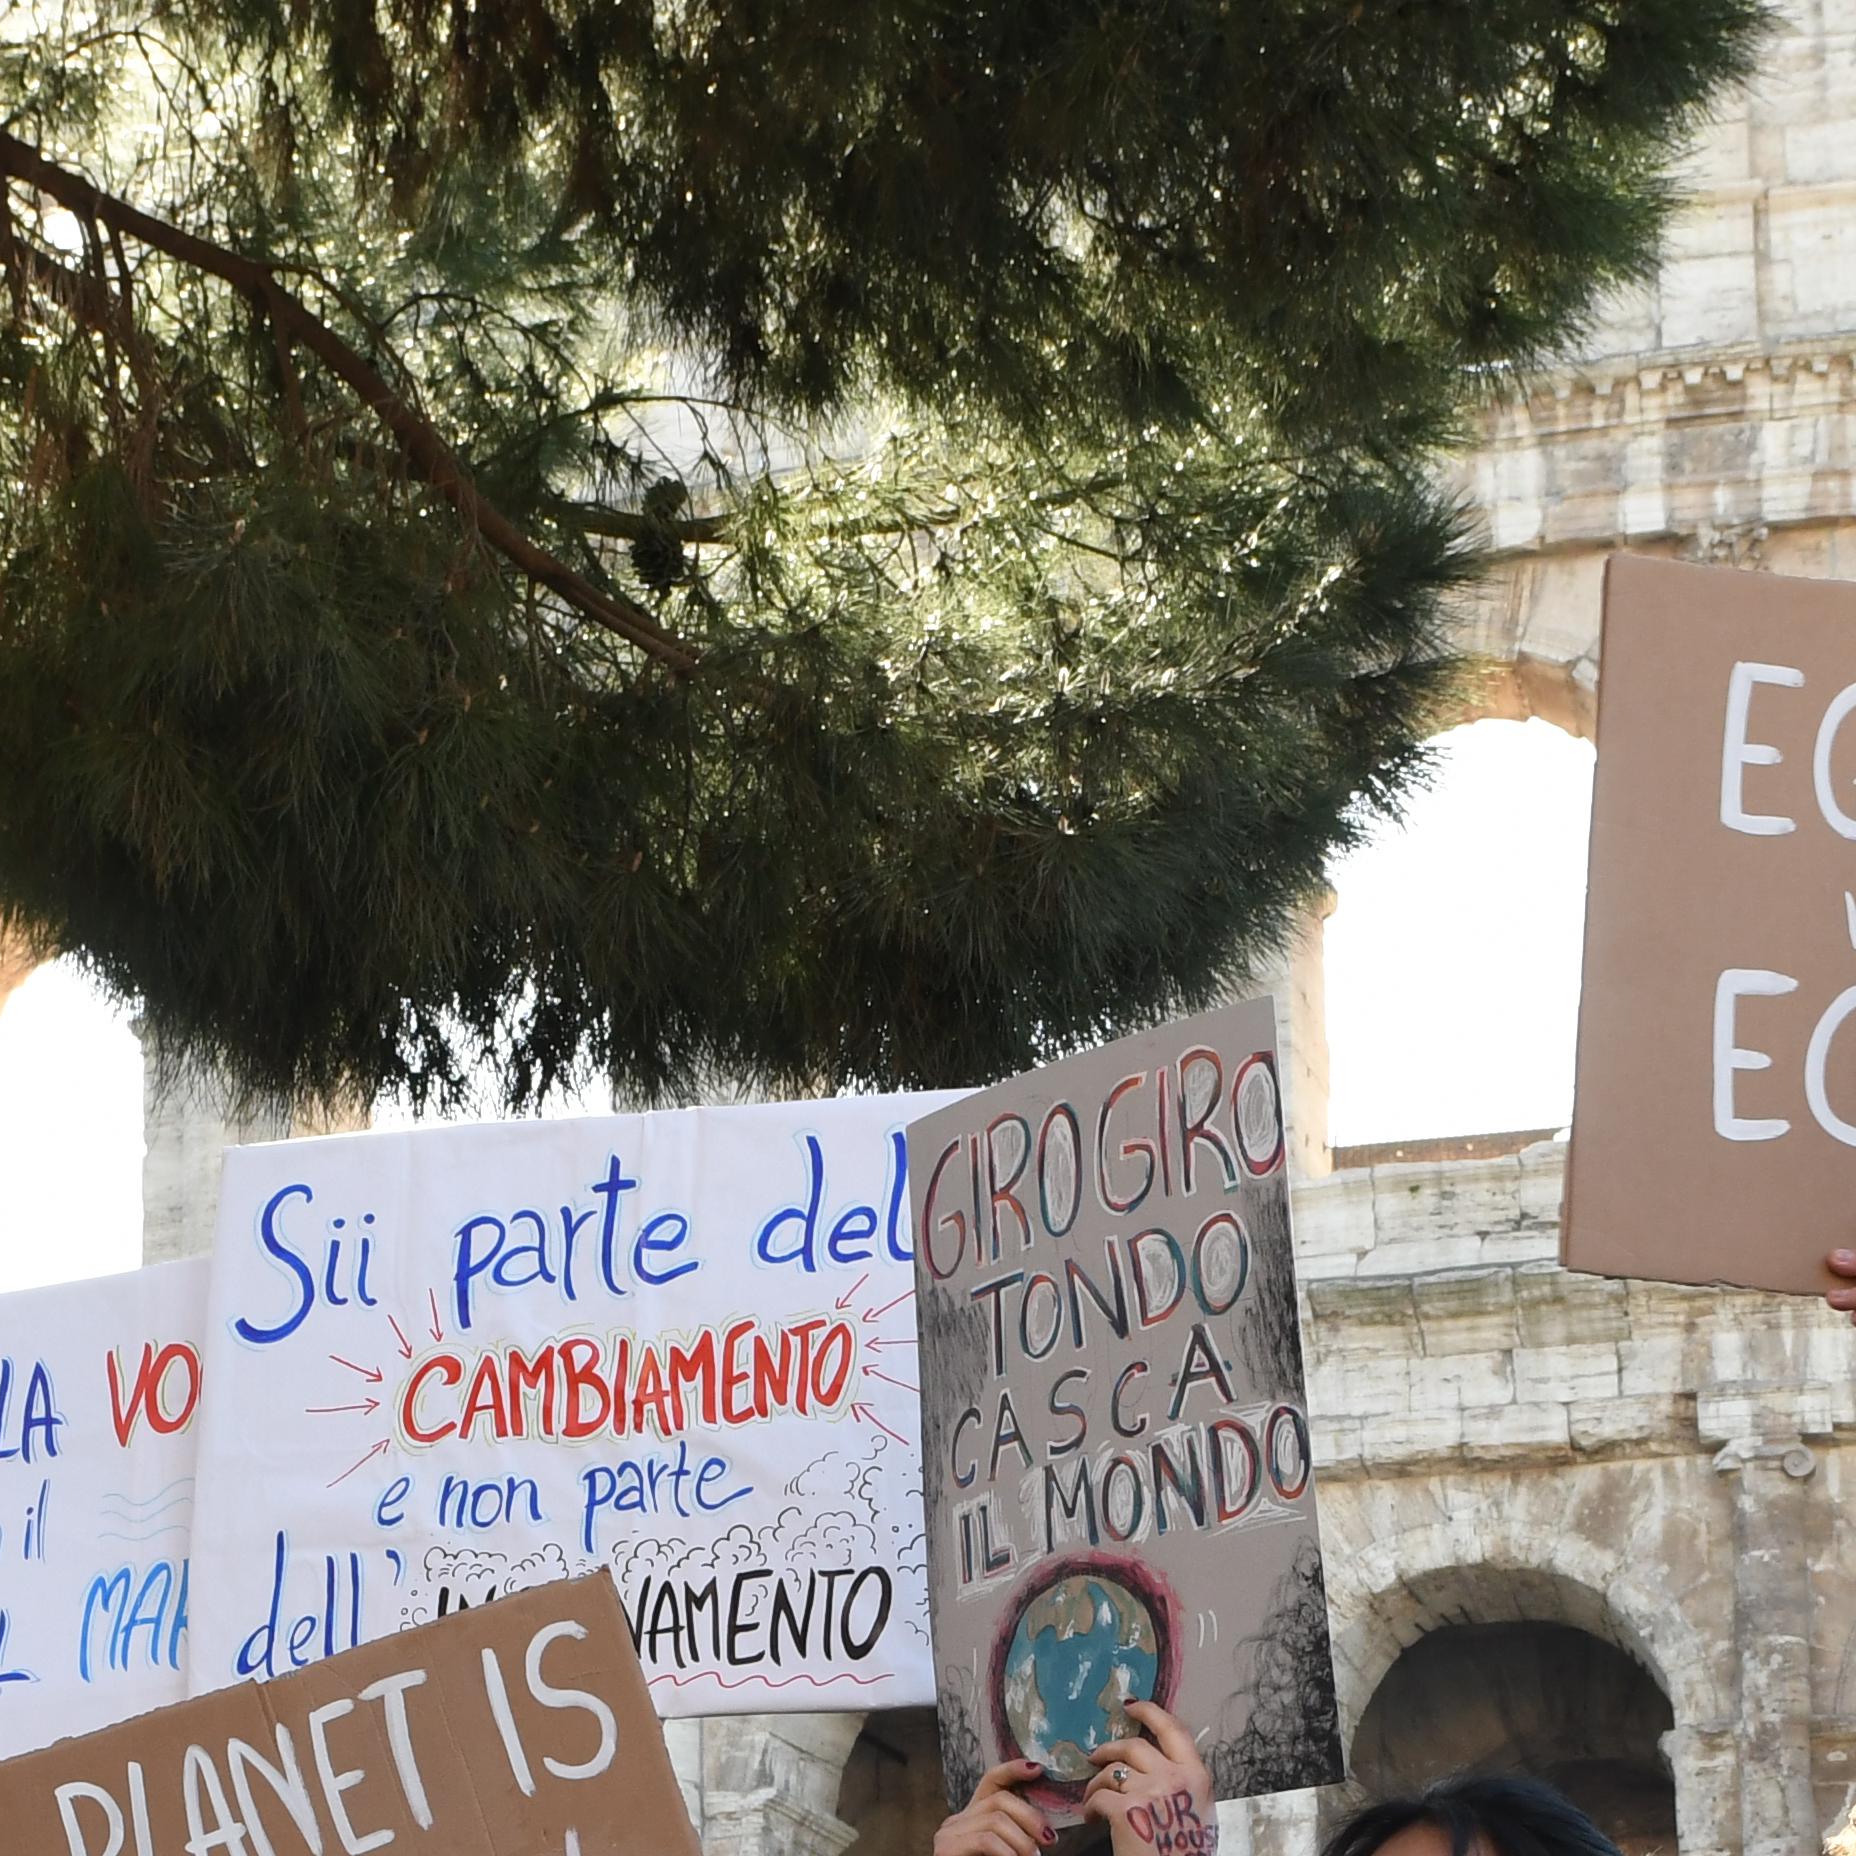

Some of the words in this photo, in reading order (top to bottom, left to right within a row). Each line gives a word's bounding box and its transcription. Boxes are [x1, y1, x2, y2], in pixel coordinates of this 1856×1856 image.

[234, 1183, 378, 1343] Sii
[455, 1154, 700, 1329] parte
[756, 1131, 914, 1272] del
[970, 1208, 1252, 1378] TONDO
[106, 1342, 202, 1449] VO
[401, 1319, 855, 1445] CAMBIAMENTO
[951, 1322, 1234, 1490] CASCA
[24, 1478, 50, 1562] il
[377, 1476, 411, 1527] e
[438, 1472, 544, 1530] non
[584, 1440, 754, 1553] parte
[959, 1502, 1012, 1586] IL
[1044, 1404, 1311, 1557] MONDO
[481, 1618, 619, 1797] IS
[1126, 1789, 1202, 1844] OUR
